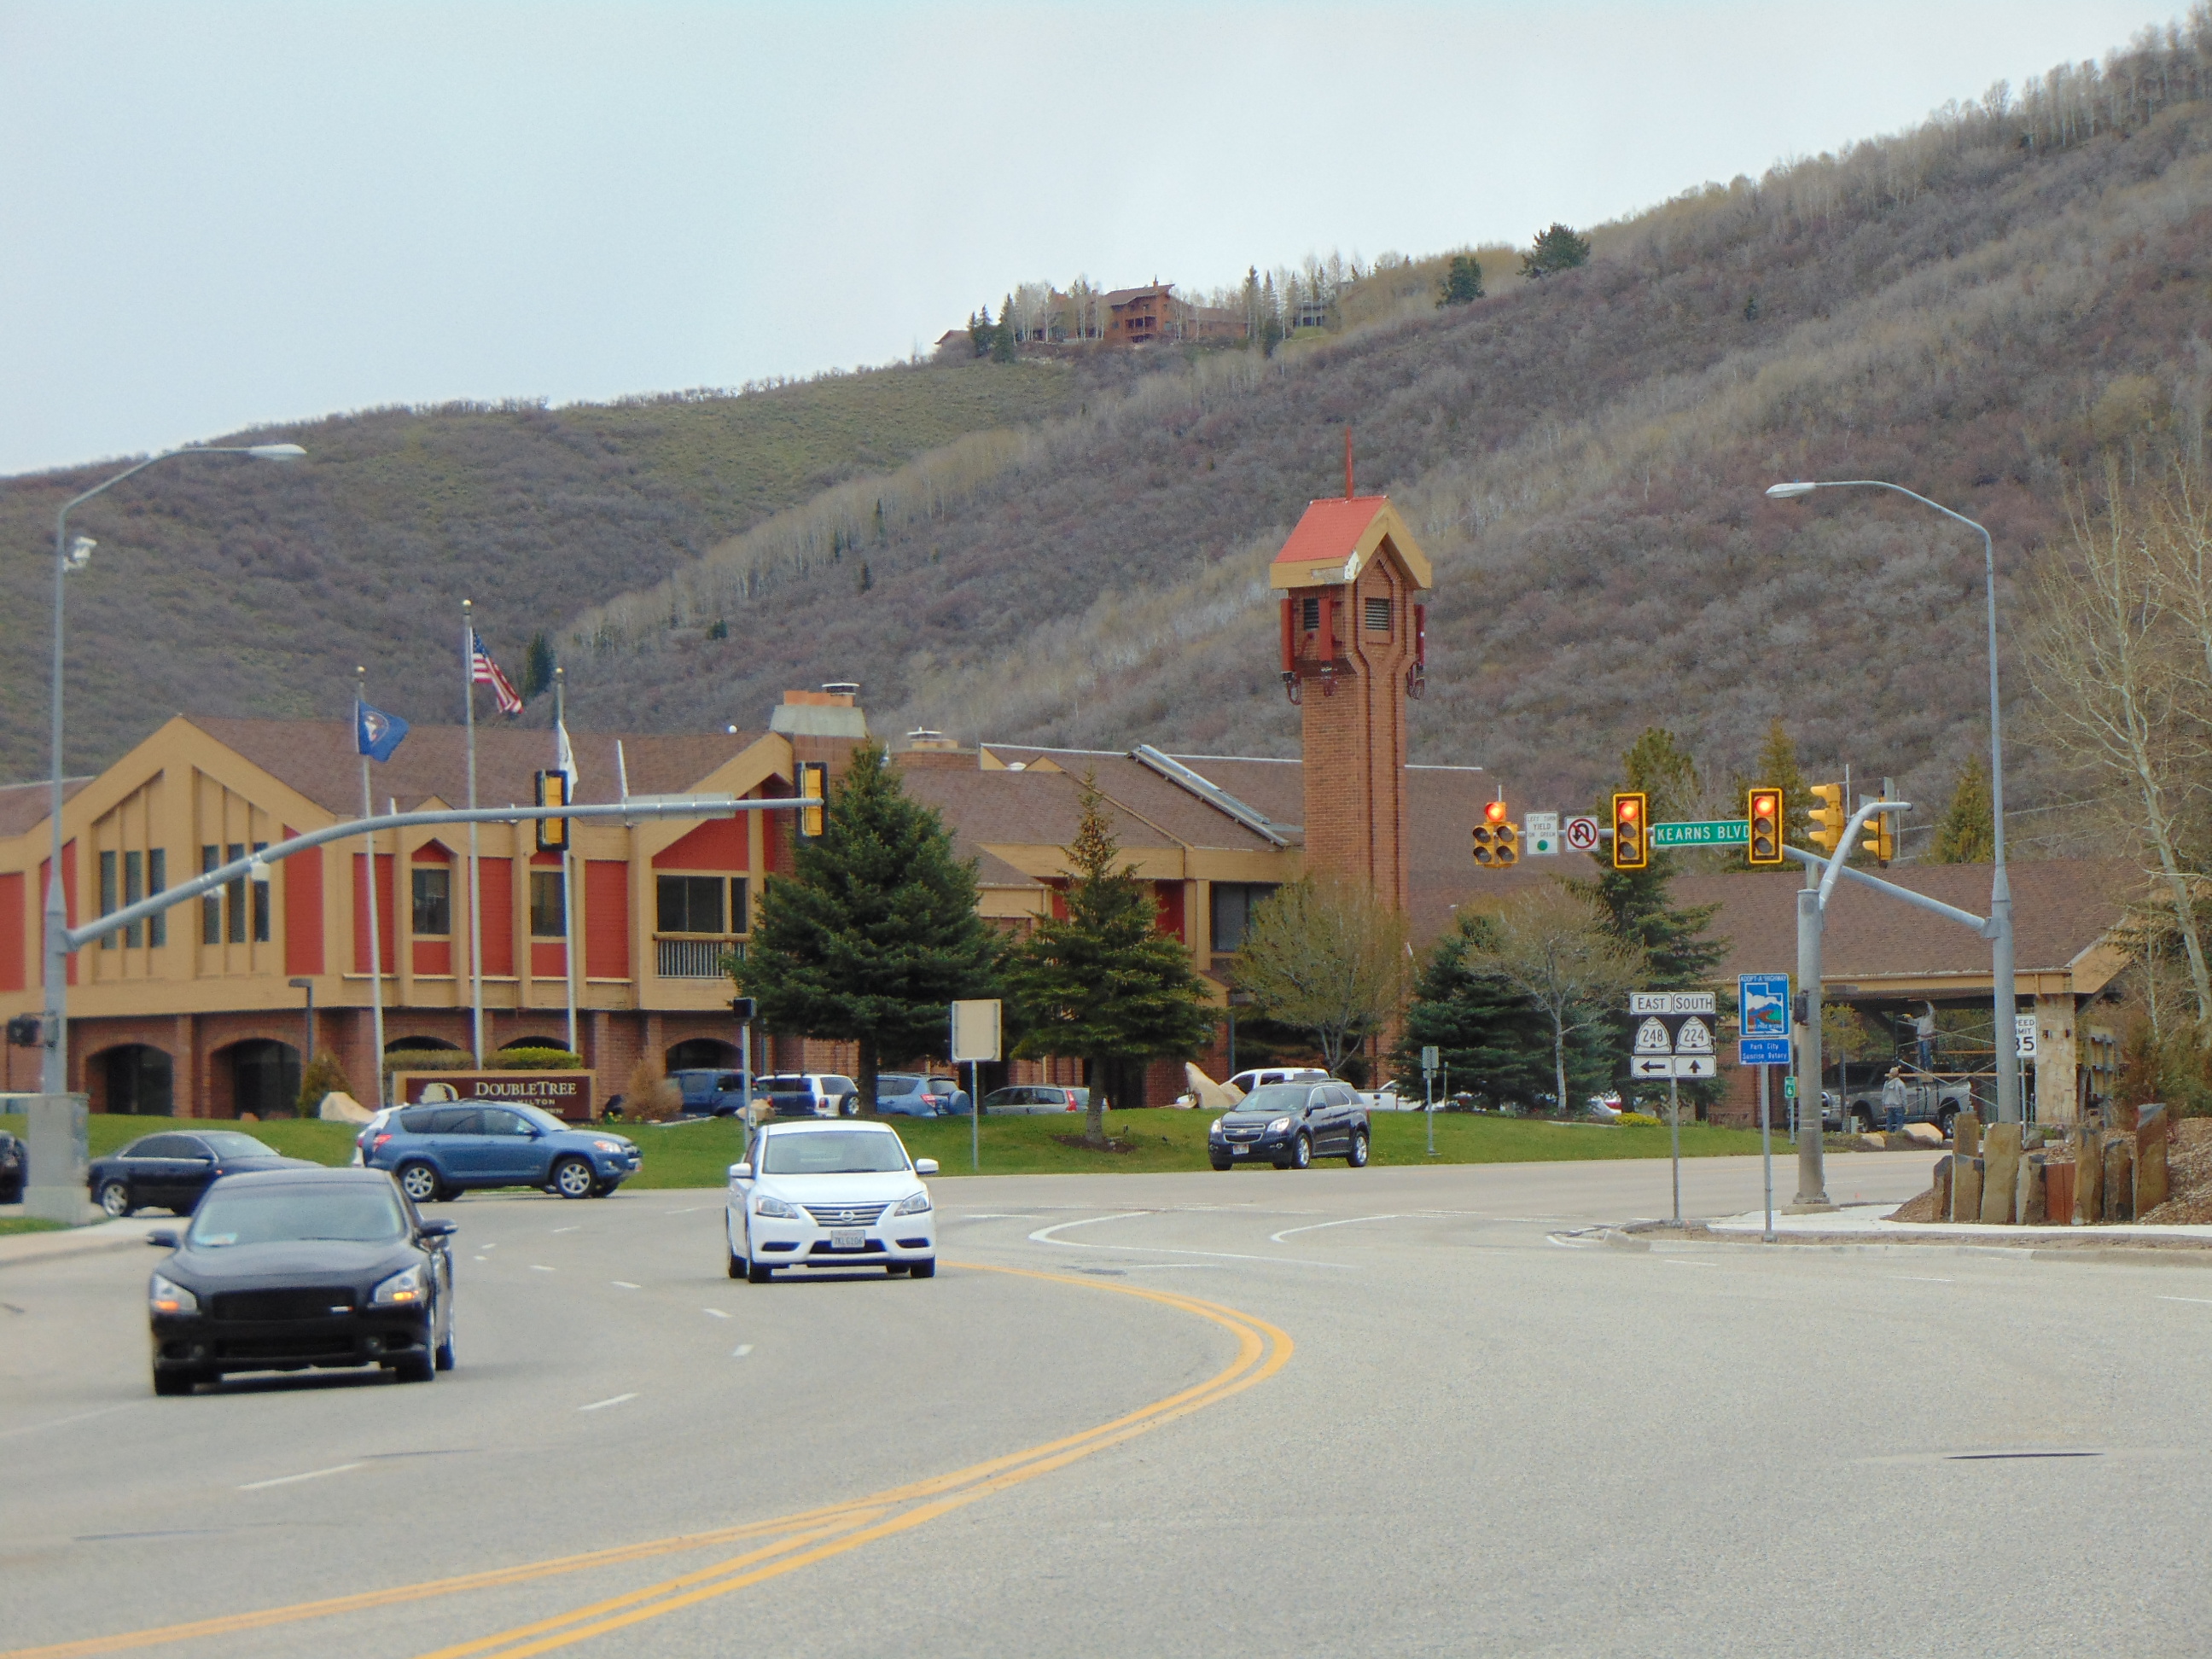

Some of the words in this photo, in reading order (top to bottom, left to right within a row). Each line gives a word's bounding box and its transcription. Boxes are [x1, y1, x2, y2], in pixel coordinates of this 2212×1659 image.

[1657, 826, 1711, 841] KEARNS
[1718, 824, 1749, 839] BLVD
[1638, 997, 1665, 1010] EAST
[1675, 997, 1713, 1010] SOUTH
[1643, 1028, 1663, 1042] 248
[1684, 1028, 1704, 1042] 224
[474, 1081, 578, 1096] DOUBLETREE
